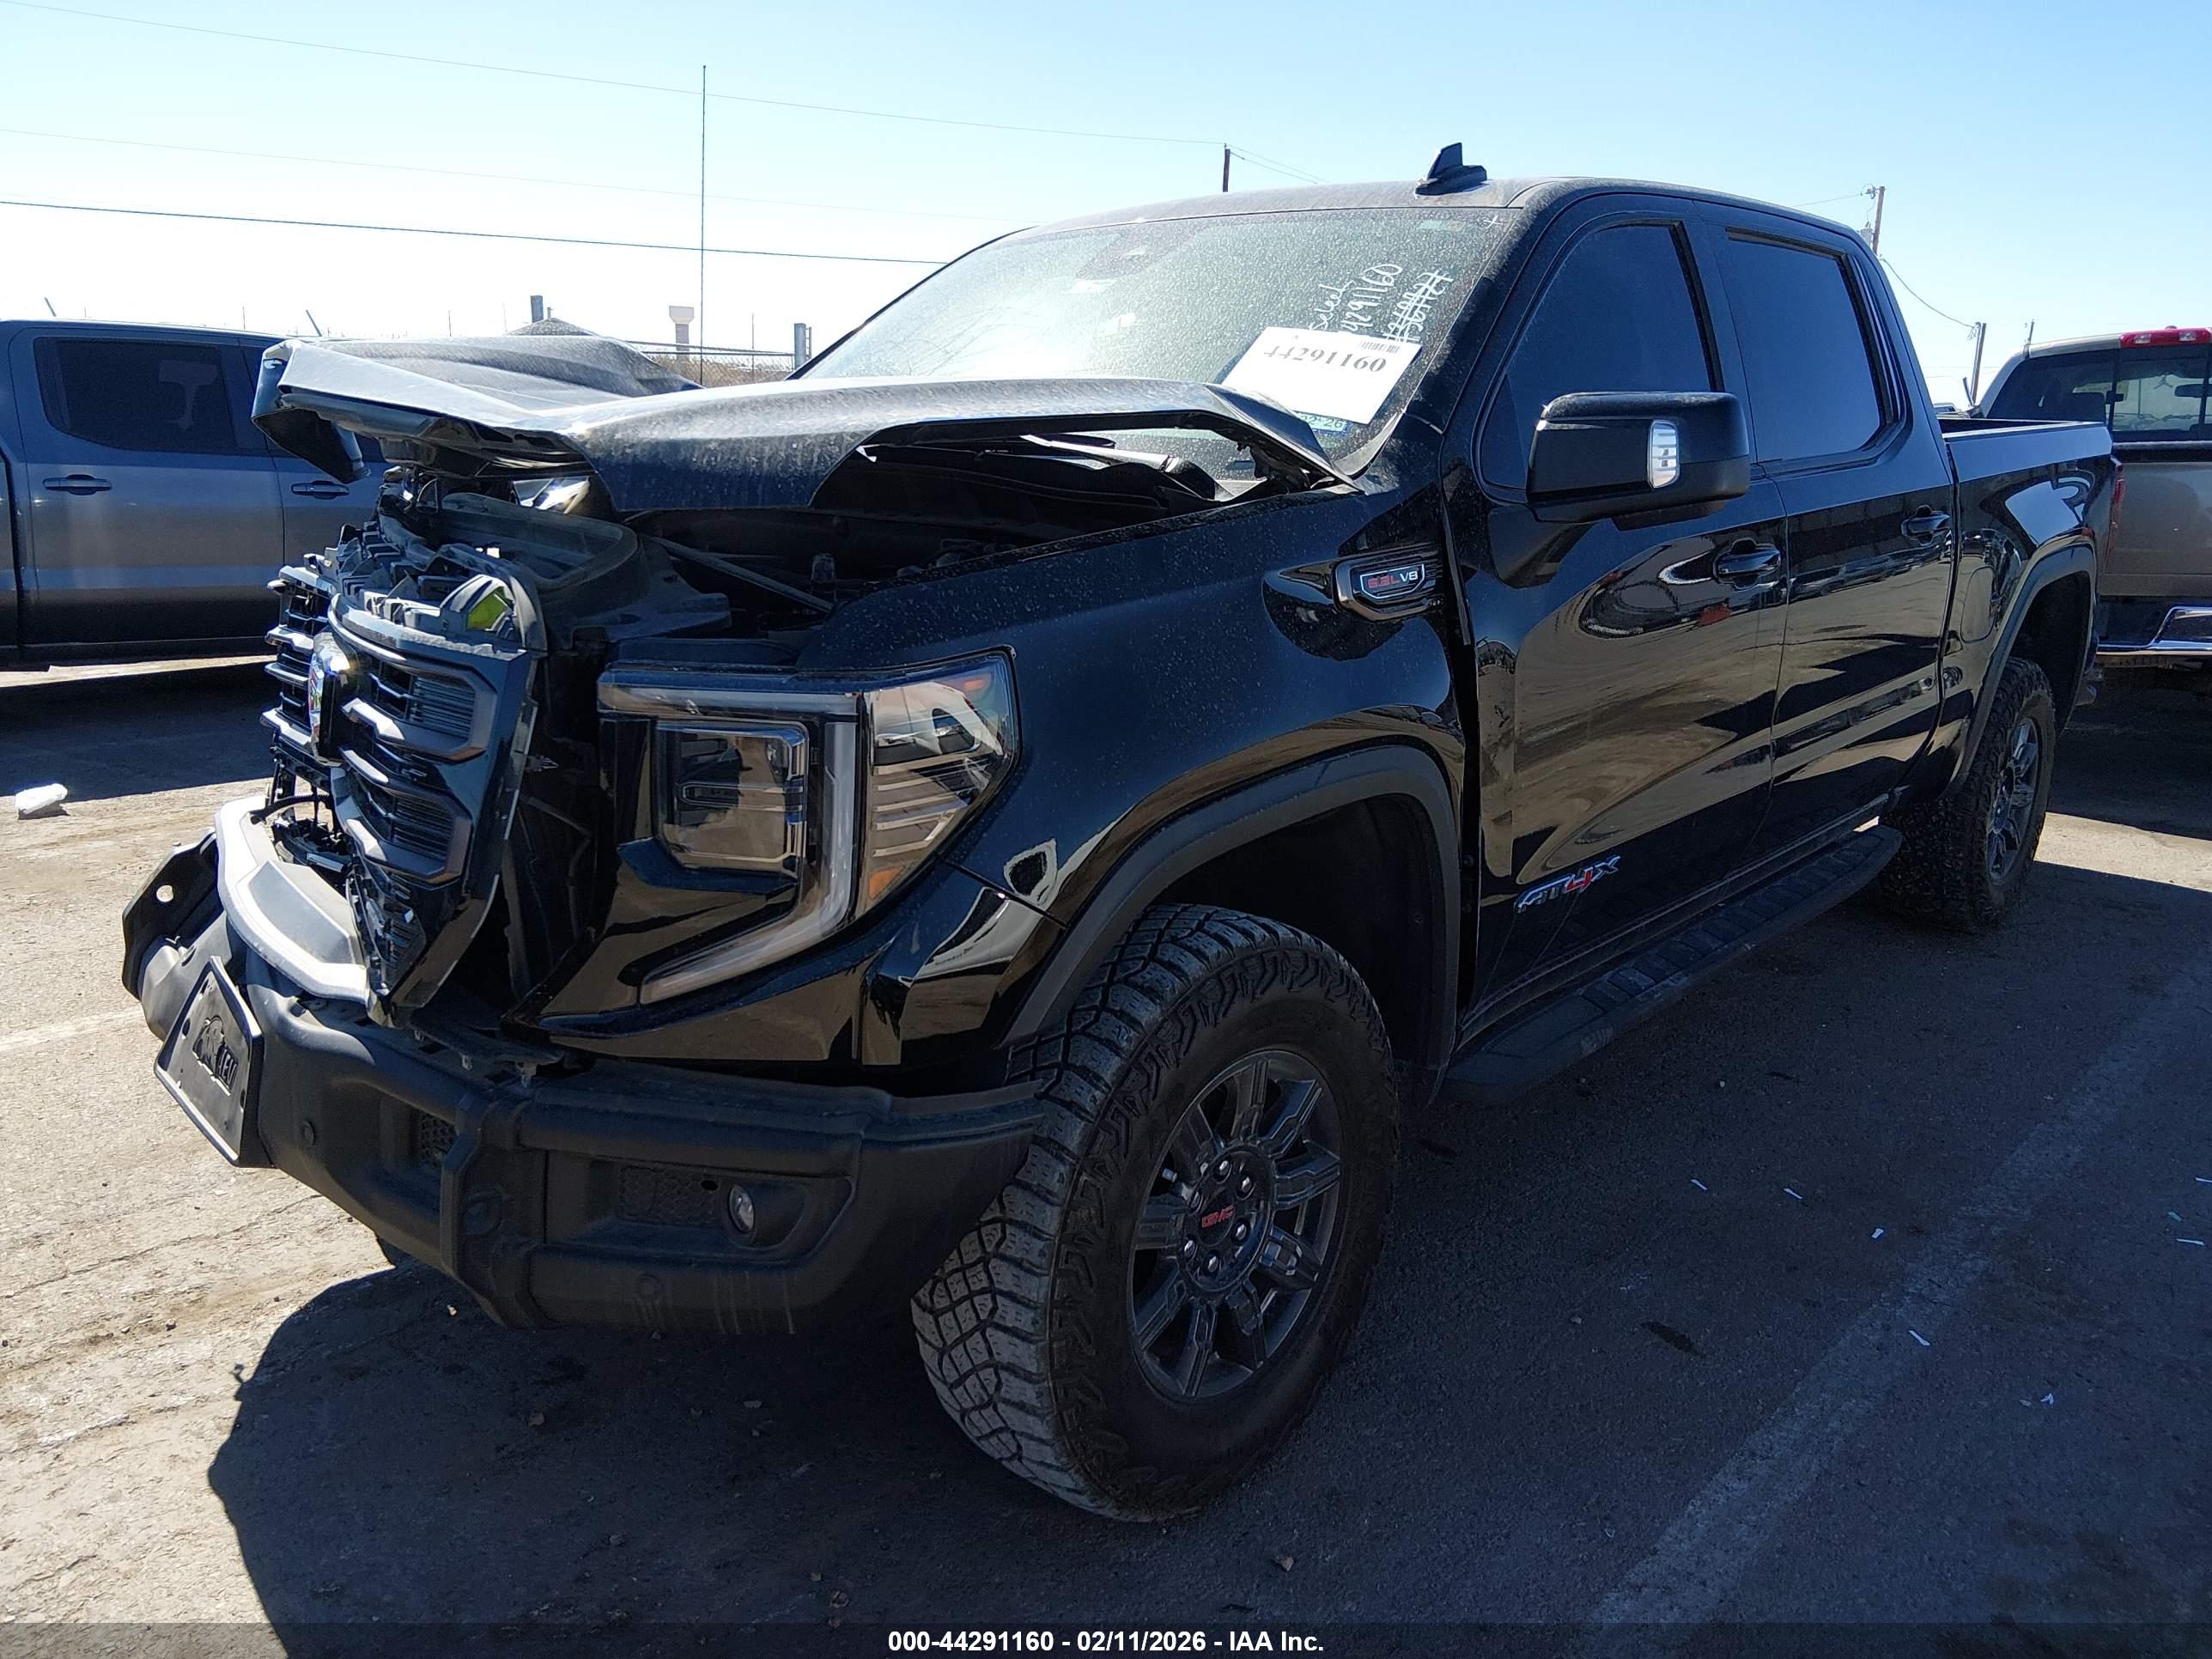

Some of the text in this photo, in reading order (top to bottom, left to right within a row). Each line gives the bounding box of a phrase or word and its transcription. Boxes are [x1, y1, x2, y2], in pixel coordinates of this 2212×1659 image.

[1263, 345, 1388, 373] 44291160
[1400, 571, 1419, 583] V8
[1515, 855, 1621, 914] AT4X
[1201, 1204, 1234, 1228] GMC
